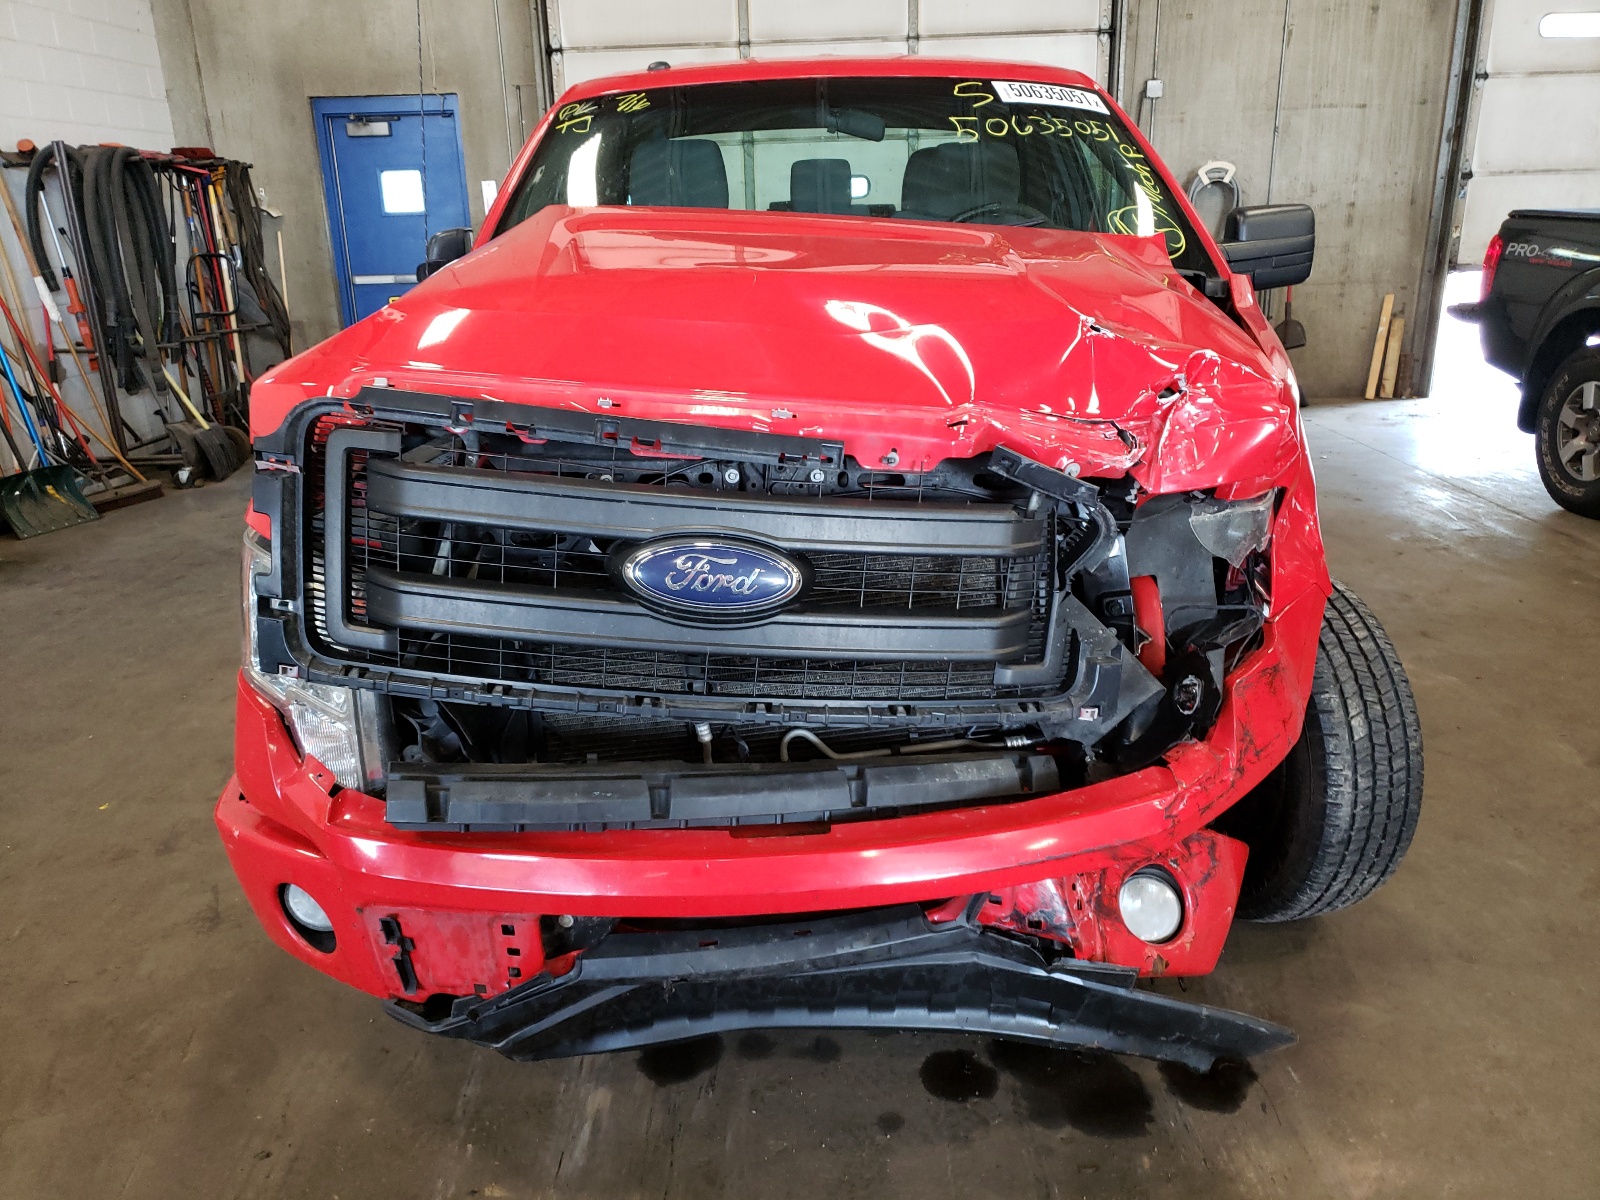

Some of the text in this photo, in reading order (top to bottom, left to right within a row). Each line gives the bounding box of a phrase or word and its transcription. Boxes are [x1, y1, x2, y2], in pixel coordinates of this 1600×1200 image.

[1008, 83, 1093, 107] 50635051
[948, 115, 1120, 144] 50635051
[665, 553, 759, 596] Ford
